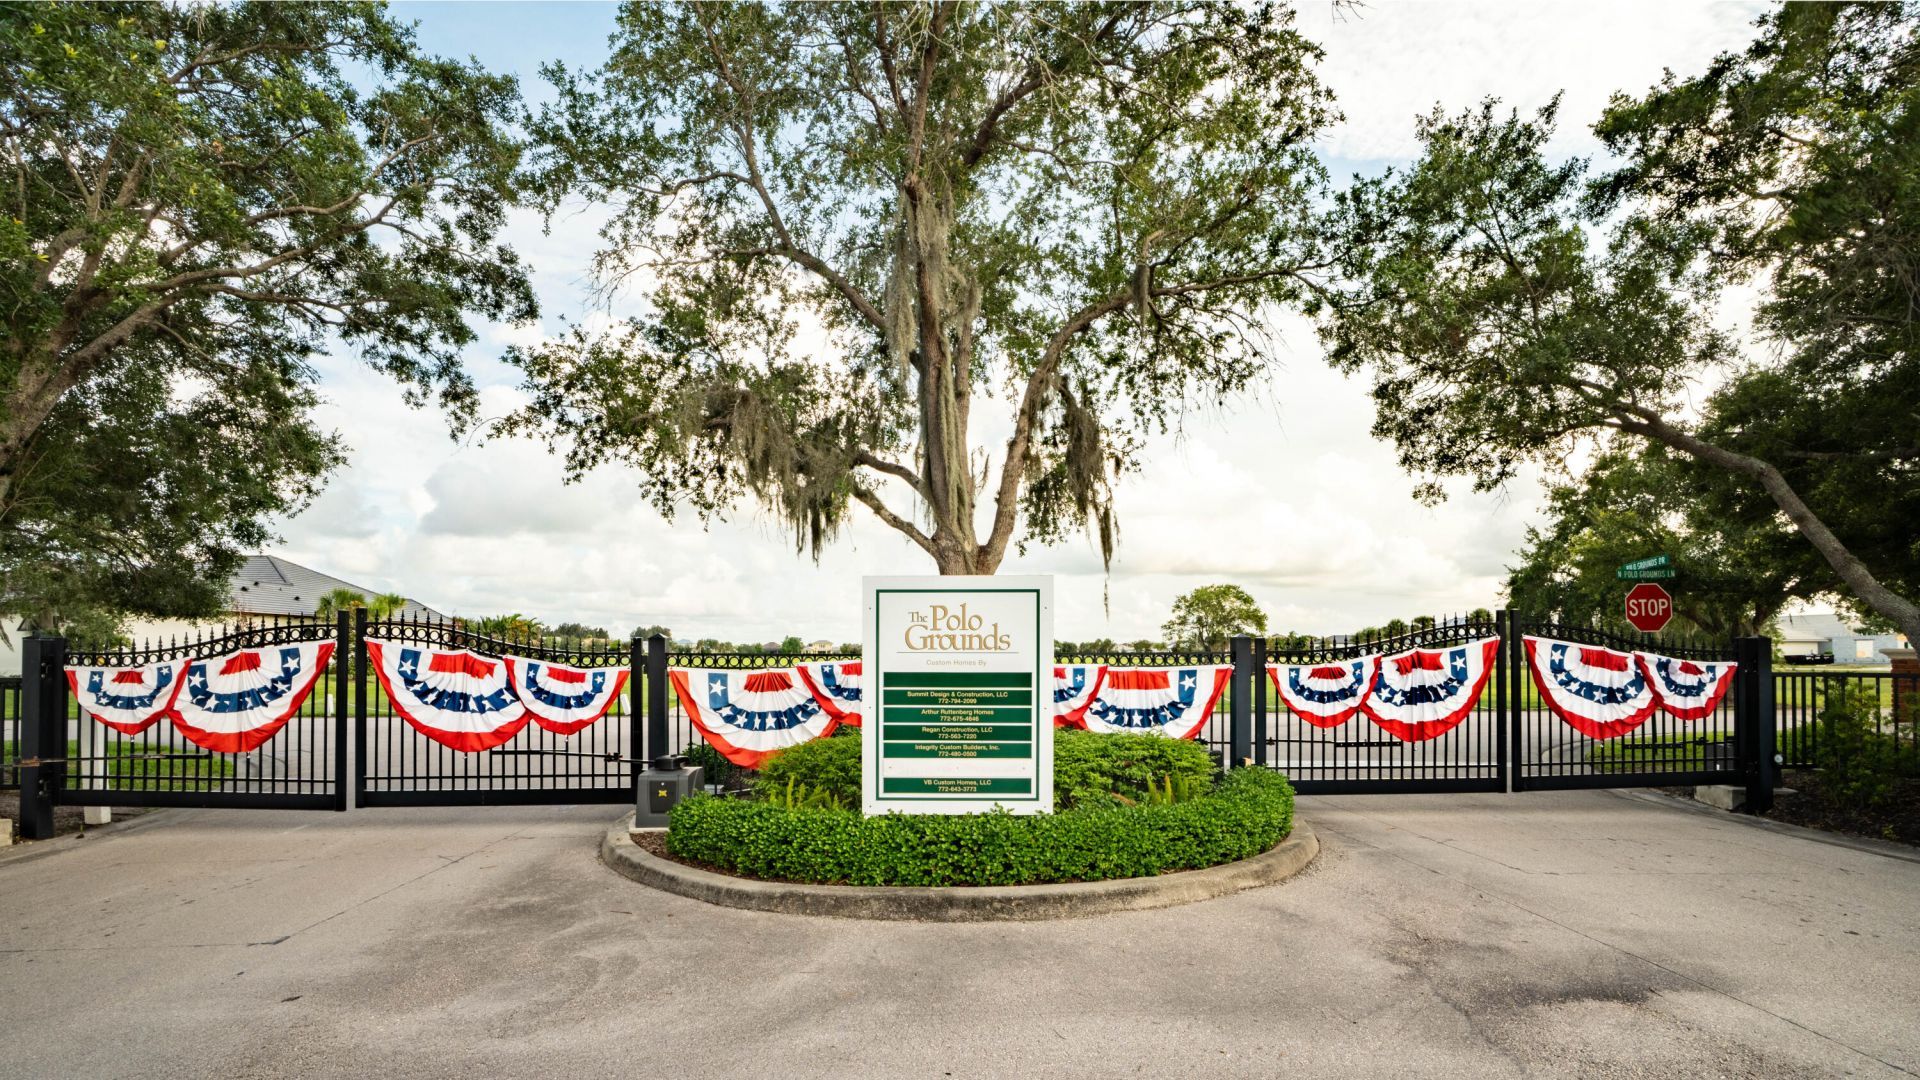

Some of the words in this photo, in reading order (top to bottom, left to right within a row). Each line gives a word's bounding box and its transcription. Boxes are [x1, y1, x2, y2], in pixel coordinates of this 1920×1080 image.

[1658, 556, 1666, 565] DR
[1624, 570, 1638, 578] POLO
[1639, 570, 1666, 578] GROUNDS
[1667, 570, 1676, 578] LN
[1629, 599, 1668, 617] STOP
[908, 611, 928, 622] The
[929, 602, 983, 631] Polo
[905, 622, 1011, 651] Grounds
[978, 659, 987, 667] By
